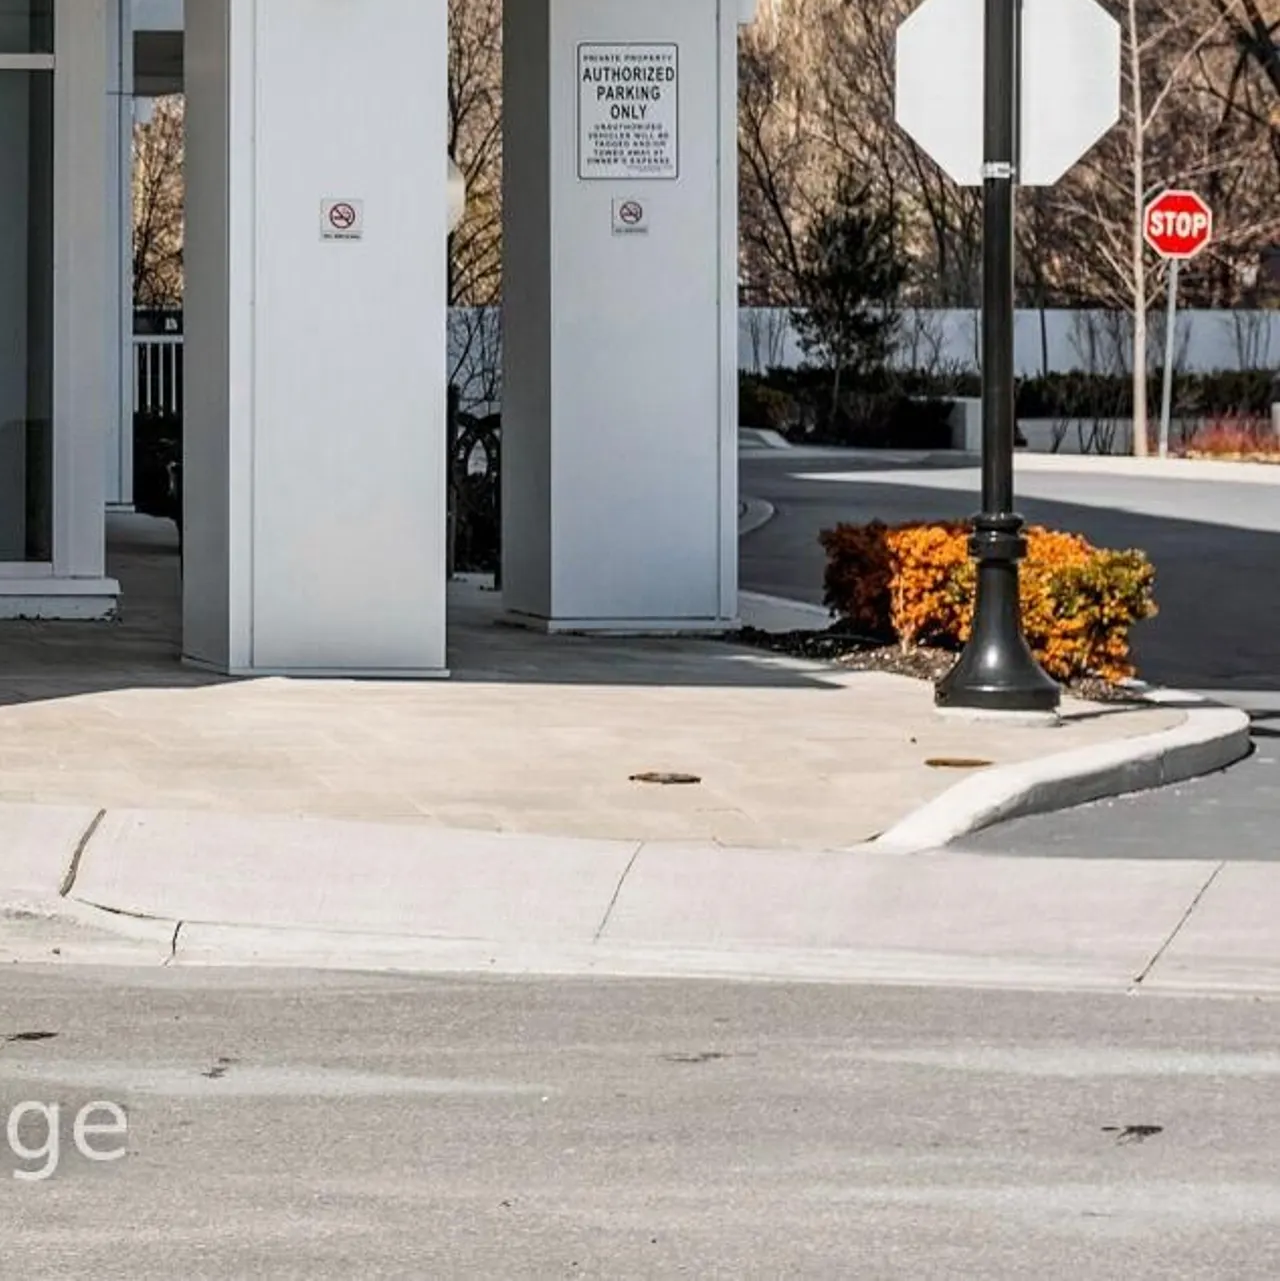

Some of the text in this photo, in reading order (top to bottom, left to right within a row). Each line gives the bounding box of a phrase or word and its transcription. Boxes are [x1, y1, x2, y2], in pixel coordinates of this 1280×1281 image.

[583, 66, 675, 82] AUTHORIZED
[596, 86, 661, 101] PARKING
[610, 104, 647, 120] ONLY
[1150, 209, 1207, 238] STOP
